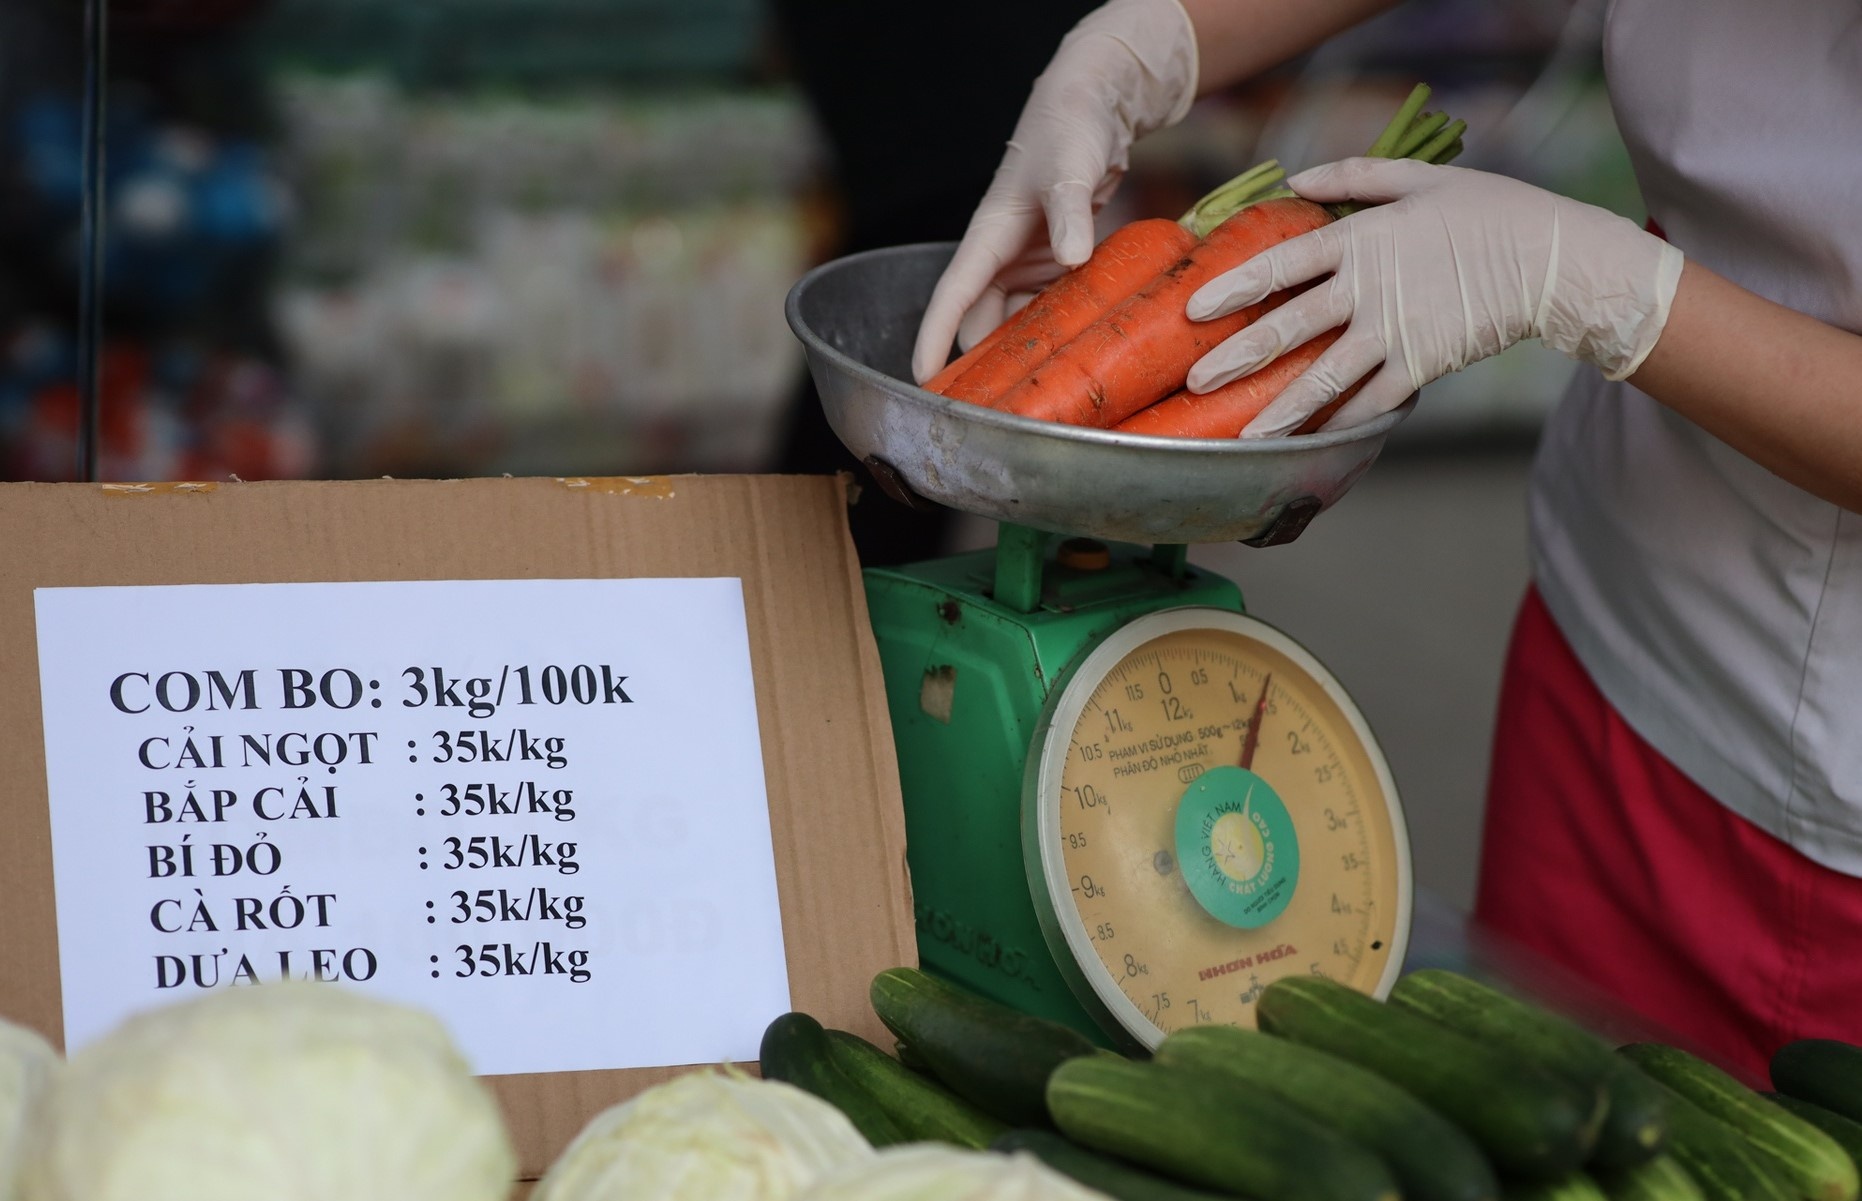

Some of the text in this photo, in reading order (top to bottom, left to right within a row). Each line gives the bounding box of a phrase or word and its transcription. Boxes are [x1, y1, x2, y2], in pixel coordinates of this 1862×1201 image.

[110, 664, 635, 721] COM BO: 3kg/100k
[139, 725, 226, 771] CẢI
[239, 731, 380, 776] NGỌT
[432, 728, 569, 770] 35k/kg
[1080, 743, 1103, 762] 10.5
[142, 778, 238, 824] BẮP
[252, 775, 340, 821] CẢI
[439, 780, 577, 823] 35k/kg
[1214, 801, 1242, 817] NAM
[146, 835, 197, 879] BÍ
[209, 830, 283, 877] ĐỎ
[442, 833, 580, 877] 35k/kg
[1069, 832, 1088, 850] 9.5
[149, 886, 220, 934] CÀ
[233, 885, 338, 932] RỐT
[450, 887, 587, 931] 35k/kg
[1097, 922, 1115, 941] 8.5
[154, 947, 262, 989] DƯA
[276, 947, 378, 984] LEO
[454, 941, 592, 985] 35k/kg
[1152, 992, 1171, 1010] 7.5
